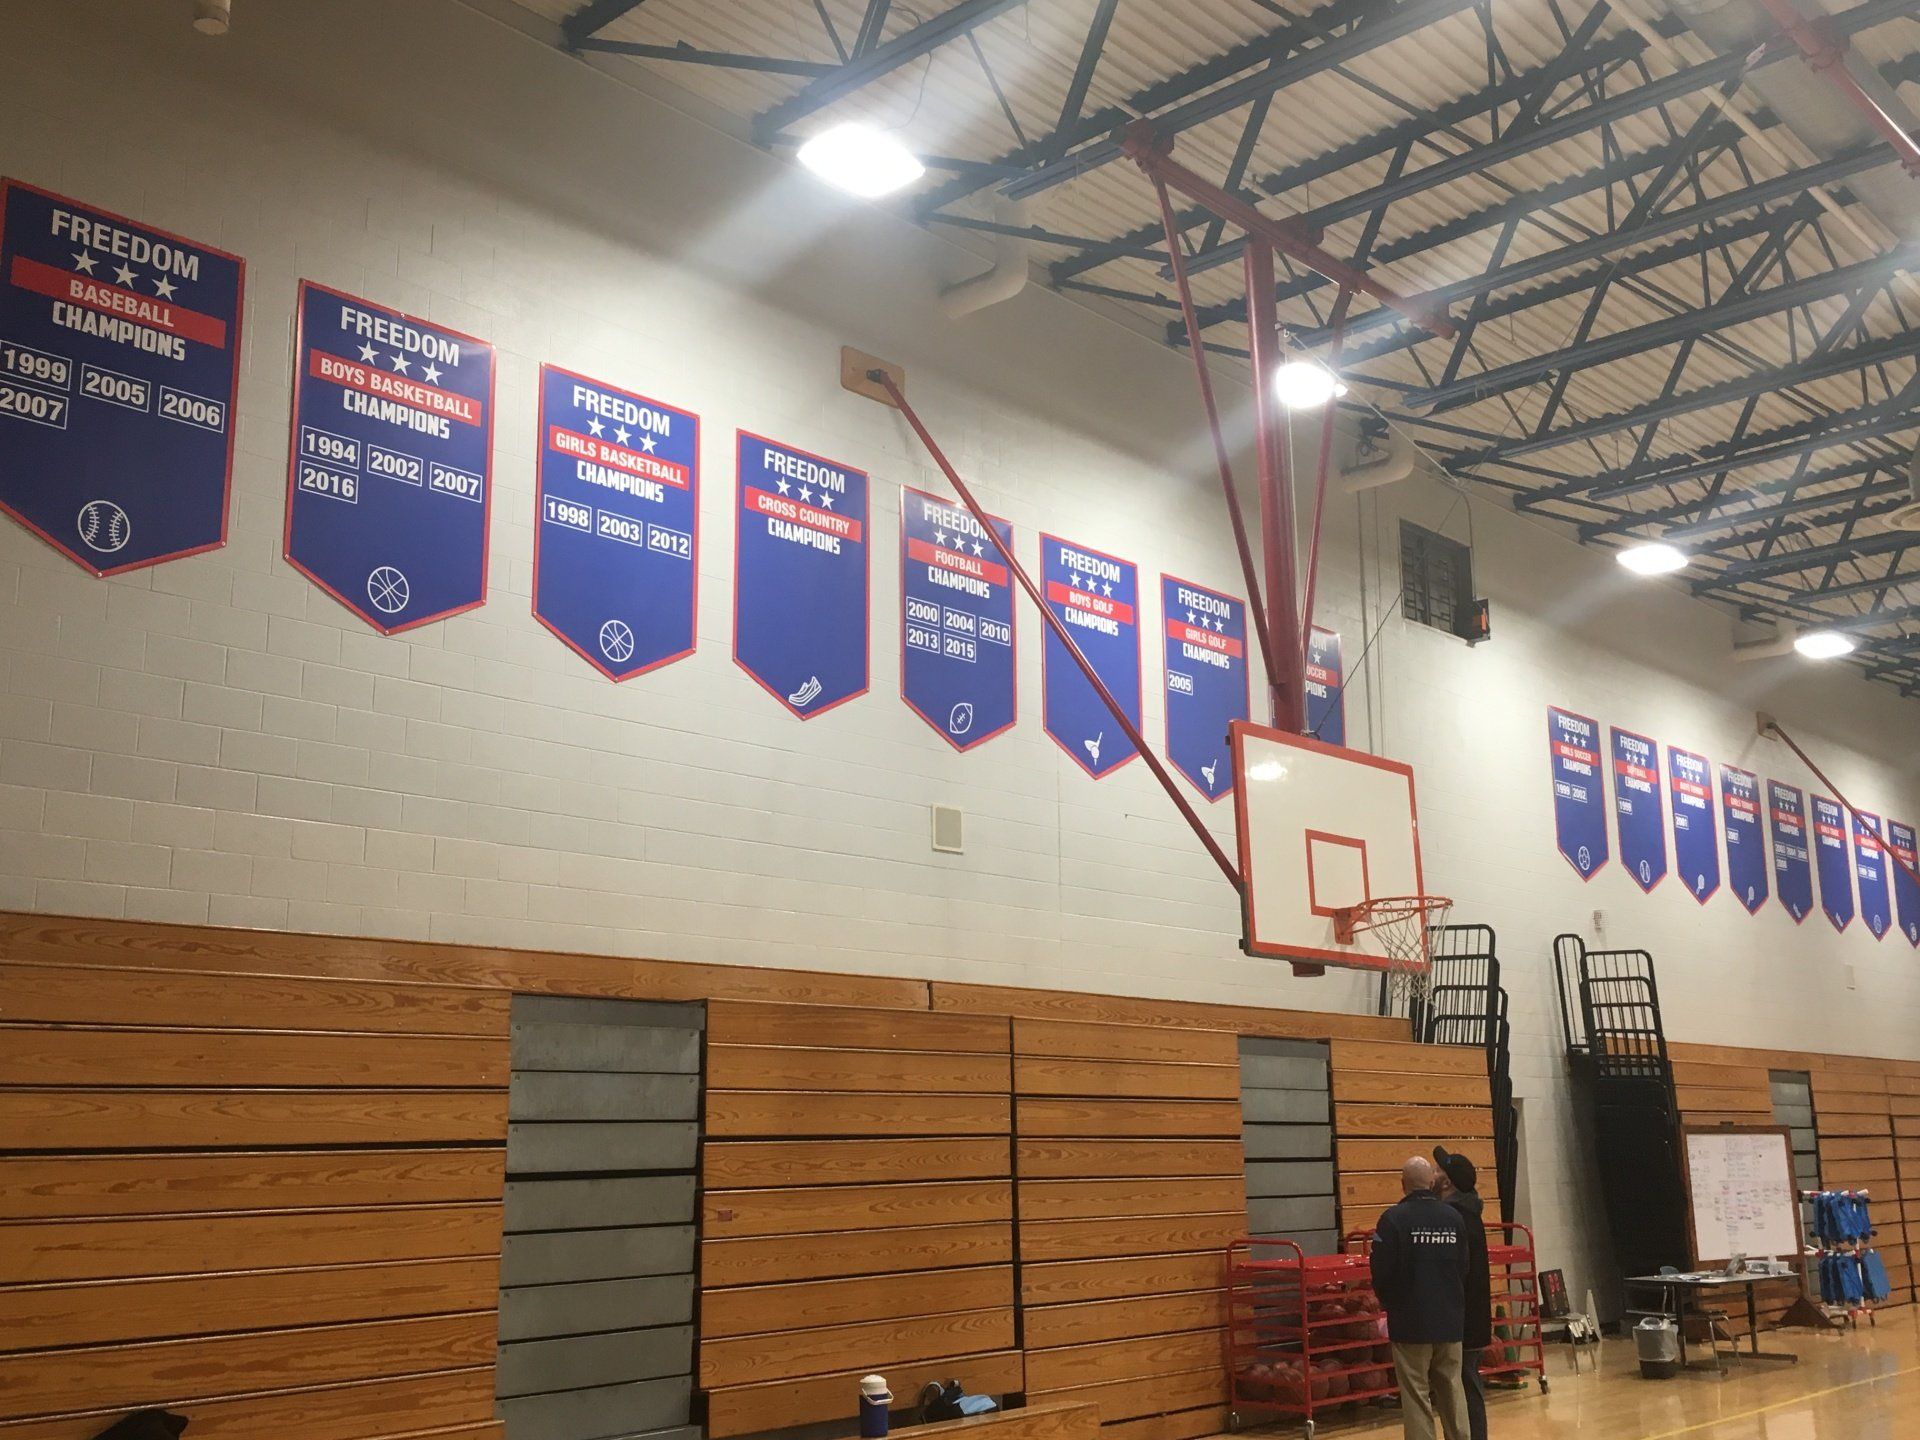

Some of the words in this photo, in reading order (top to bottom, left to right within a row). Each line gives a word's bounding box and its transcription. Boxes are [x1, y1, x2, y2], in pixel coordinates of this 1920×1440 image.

[51, 208, 200, 282] FREEDOM
[69, 279, 175, 328] BASEBALL
[52, 301, 186, 362] CHAMPIONS
[341, 305, 459, 367] FREEDOM
[0, 386, 64, 421] 2007
[4, 348, 67, 384] 1999
[85, 371, 146, 407] 2005
[163, 393, 221, 427] 2006
[320, 357, 365, 385] BOYS
[370, 373, 472, 419] BASKETBALL
[343, 388, 450, 439] CHAMPIONS
[573, 384, 670, 437] FREEDOM
[306, 433, 356, 463] 1994
[370, 451, 419, 481] 2002
[433, 468, 479, 496] 2007
[556, 432, 597, 458] GIRLS
[601, 446, 684, 485] BASKETBALL
[764, 448, 845, 494] FREEDOM
[303, 467, 354, 498] 2016
[577, 460, 664, 503] CHAMPIONS
[548, 501, 589, 527] 1998
[600, 515, 640, 541] 2003
[651, 529, 689, 555] 2012
[758, 494, 796, 519] CROSS
[799, 507, 850, 535] COUNTRY
[767, 517, 841, 555] CHAMPIONS
[935, 550, 983, 576] FOOTBALL
[1060, 547, 1120, 583] FREEDOM
[928, 566, 990, 599] CHAMPIONS
[1069, 590, 1091, 608] BOYS
[1092, 598, 1114, 615] GOLF
[1178, 587, 1231, 619] FREEDOM
[908, 601, 938, 623] 2000
[945, 611, 974, 632] 2004
[981, 621, 1009, 642] 2010
[1065, 606, 1119, 637] CHAMPIONS
[1185, 628, 1207, 644] GIRLS
[1208, 635, 1227, 650] GOLF
[908, 628, 938, 650] 2013
[945, 638, 974, 659] 2015
[1183, 642, 1230, 669] CHAMPIONS
[1169, 674, 1192, 692] 2005
[1306, 665, 1327, 681] OCCER
[1558, 715, 1590, 737] FREEDOM
[1620, 735, 1649, 756] FREEDOM
[1563, 758, 1592, 776] CHAMPIONS
[1625, 776, 1652, 794] CHAMPIONS
[1410, 1231, 1457, 1244] TITANS
